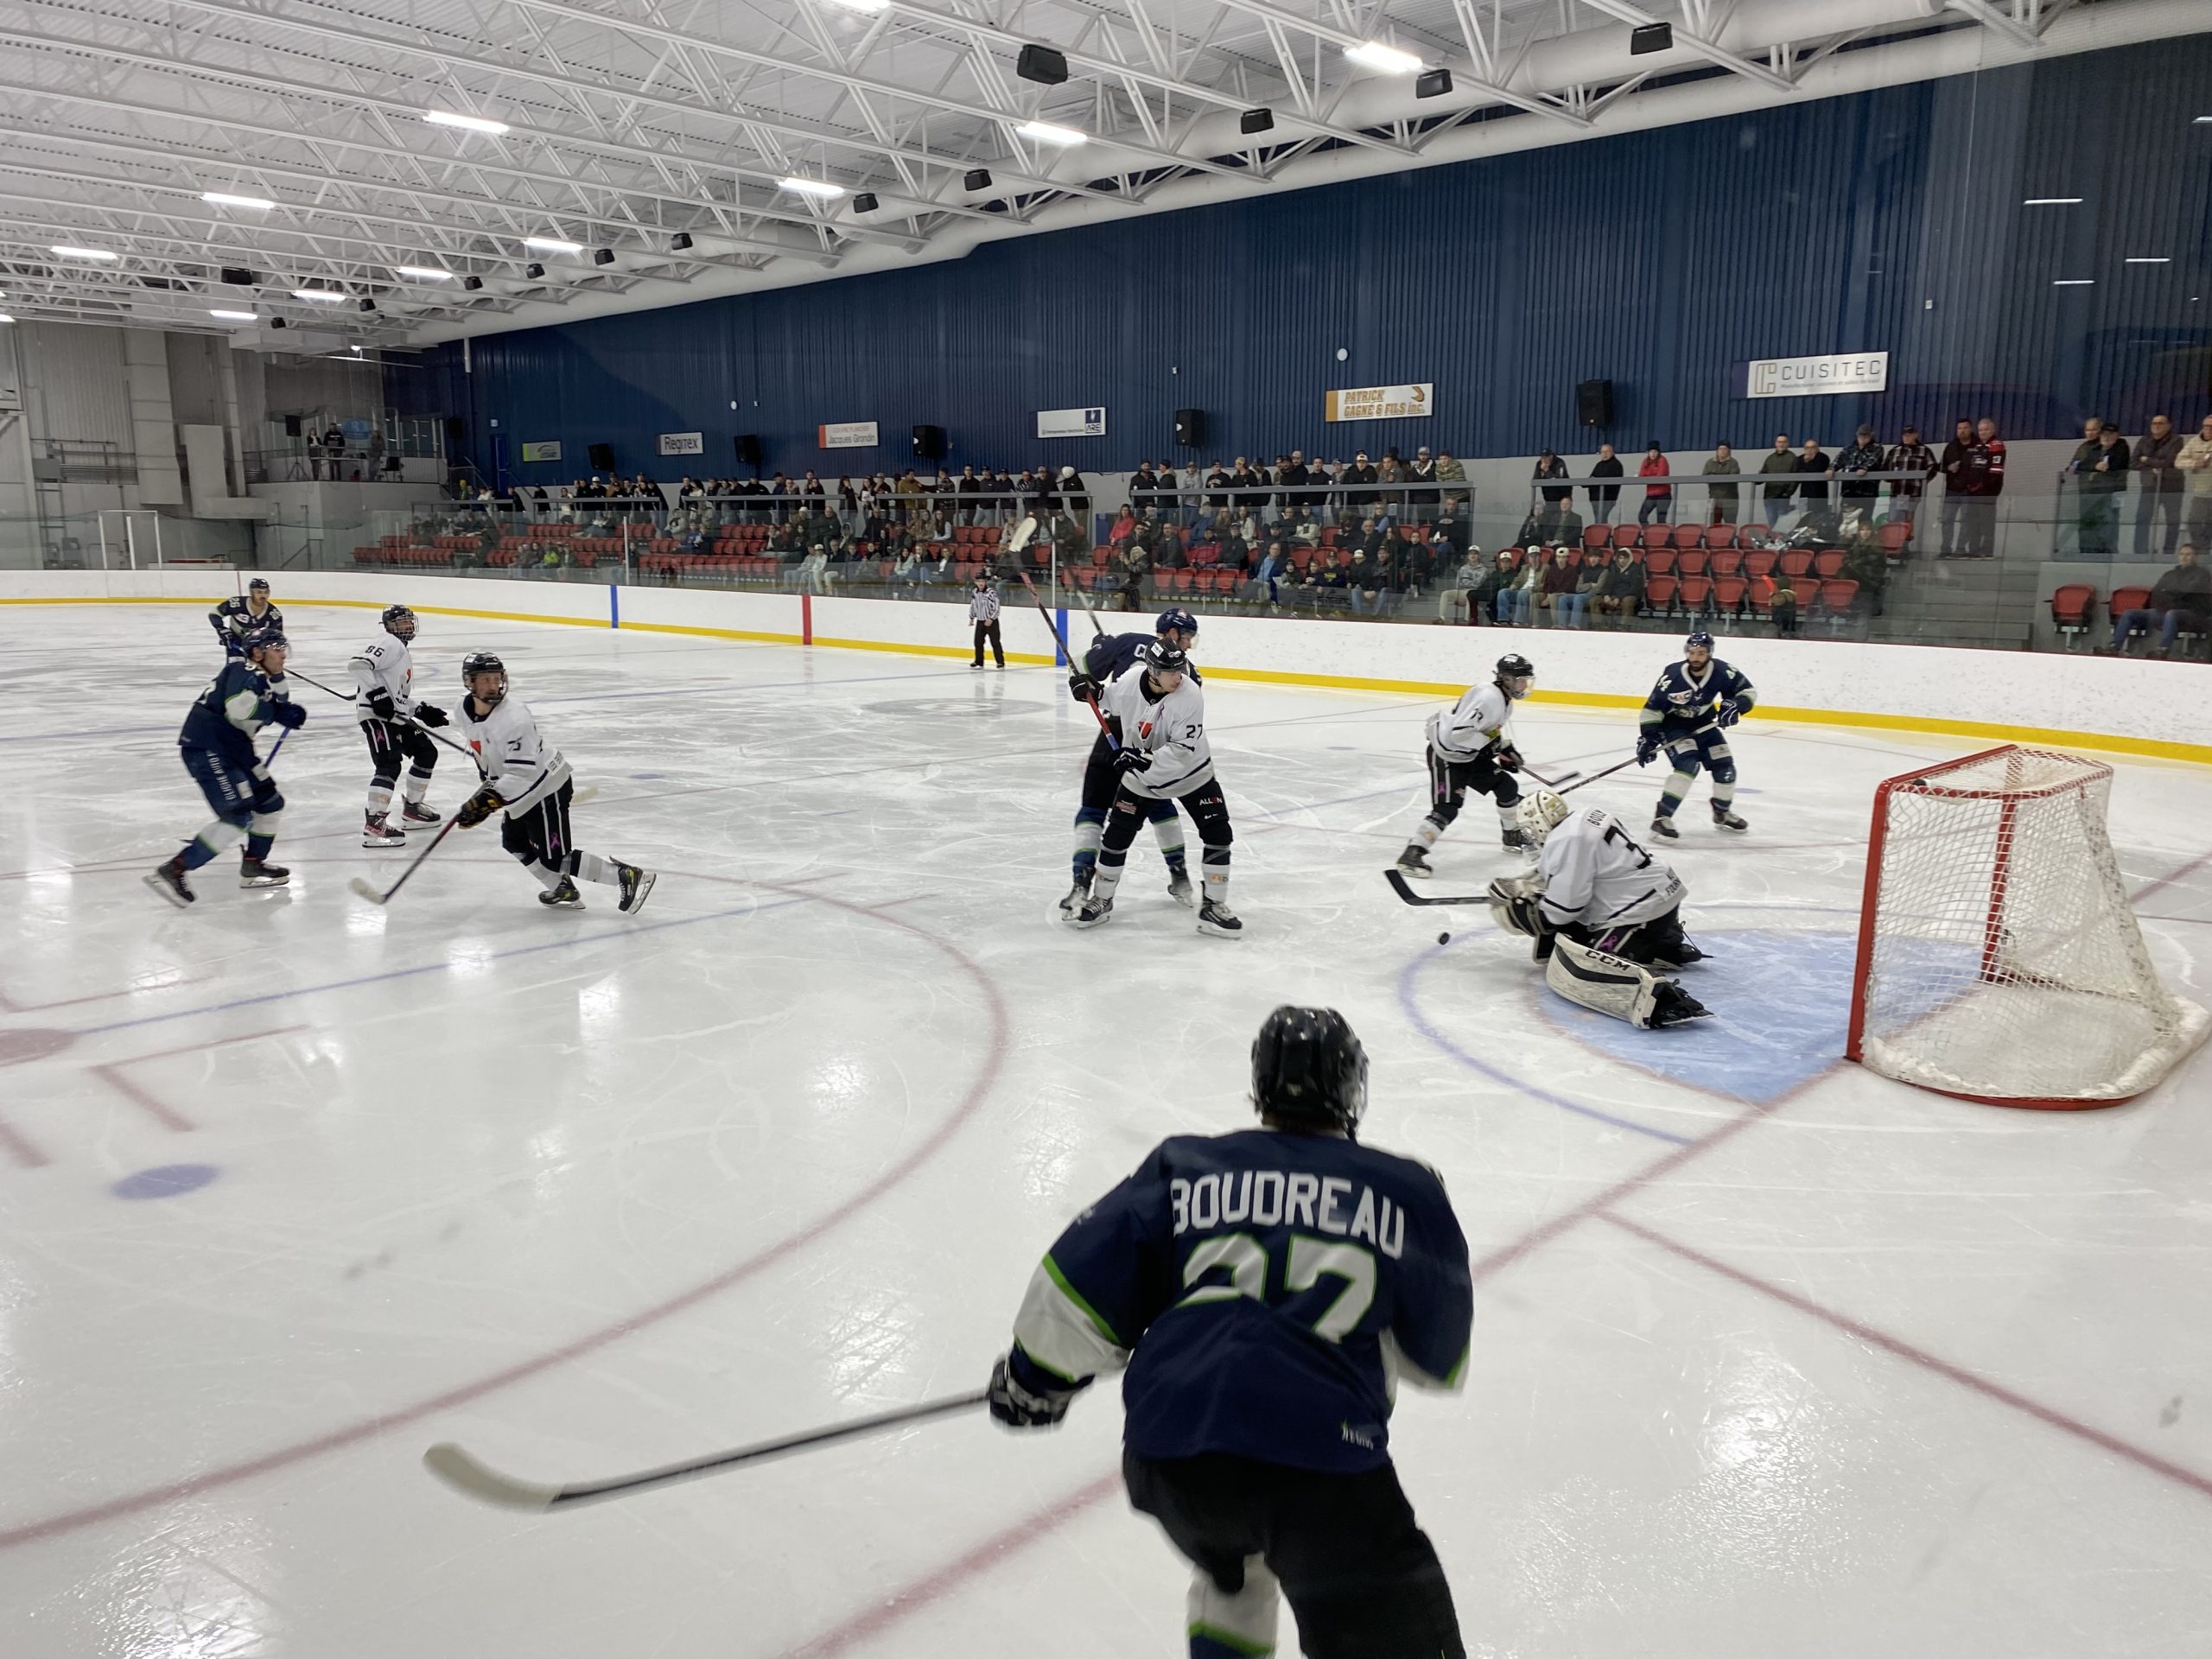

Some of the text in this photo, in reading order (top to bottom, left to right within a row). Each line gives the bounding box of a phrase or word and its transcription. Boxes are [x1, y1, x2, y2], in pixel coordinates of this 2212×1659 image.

[1782, 359, 1881, 380] CUISITEC
[1344, 389, 1386, 402] PATRICK
[1385, 402, 1406, 414] FILS
[365, 645, 385, 658] 86
[1185, 724, 1204, 740] 27
[1585, 950, 1631, 970] CCM
[1170, 1170, 1406, 1260] BOUDREAU
[1173, 1232, 1377, 1345] 27
